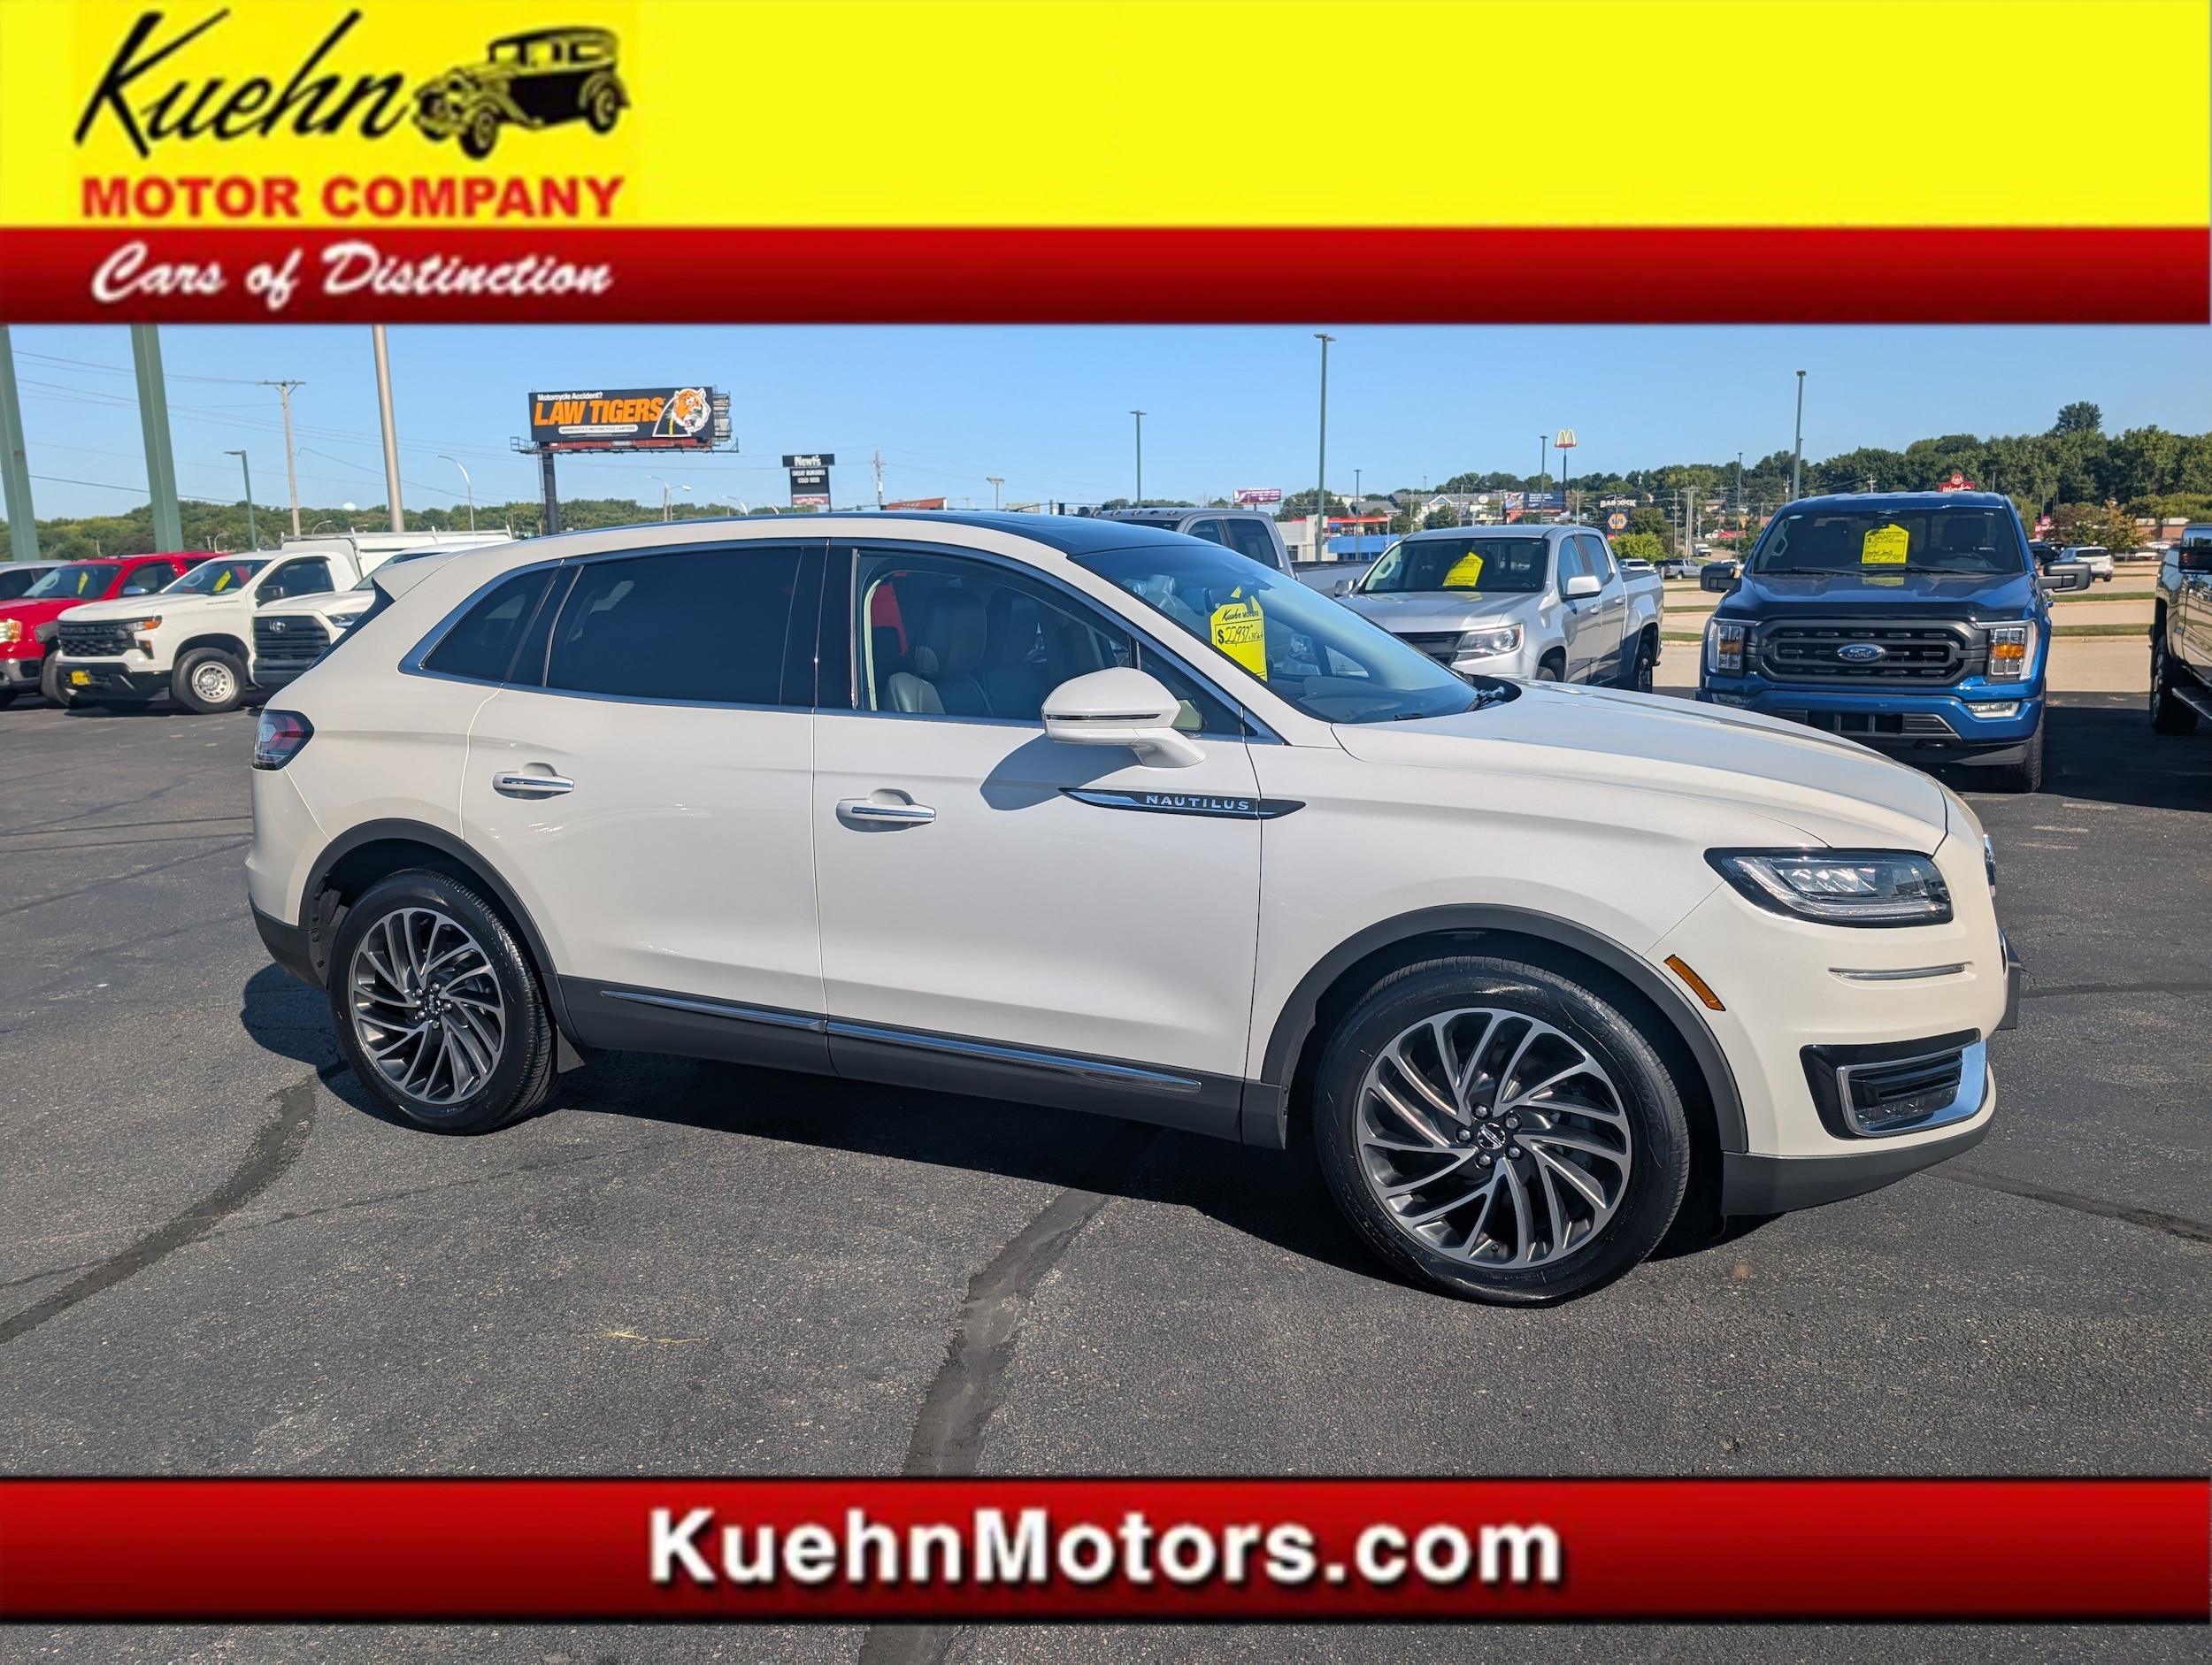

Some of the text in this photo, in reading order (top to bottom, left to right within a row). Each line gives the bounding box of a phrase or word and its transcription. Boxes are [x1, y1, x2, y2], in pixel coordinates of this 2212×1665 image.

[572, 391, 603, 400] Accident?
[534, 396, 665, 426] LAW TIGERS
[794, 455, 822, 467] Newt's
[1145, 794, 1249, 811] NAUTILUS
